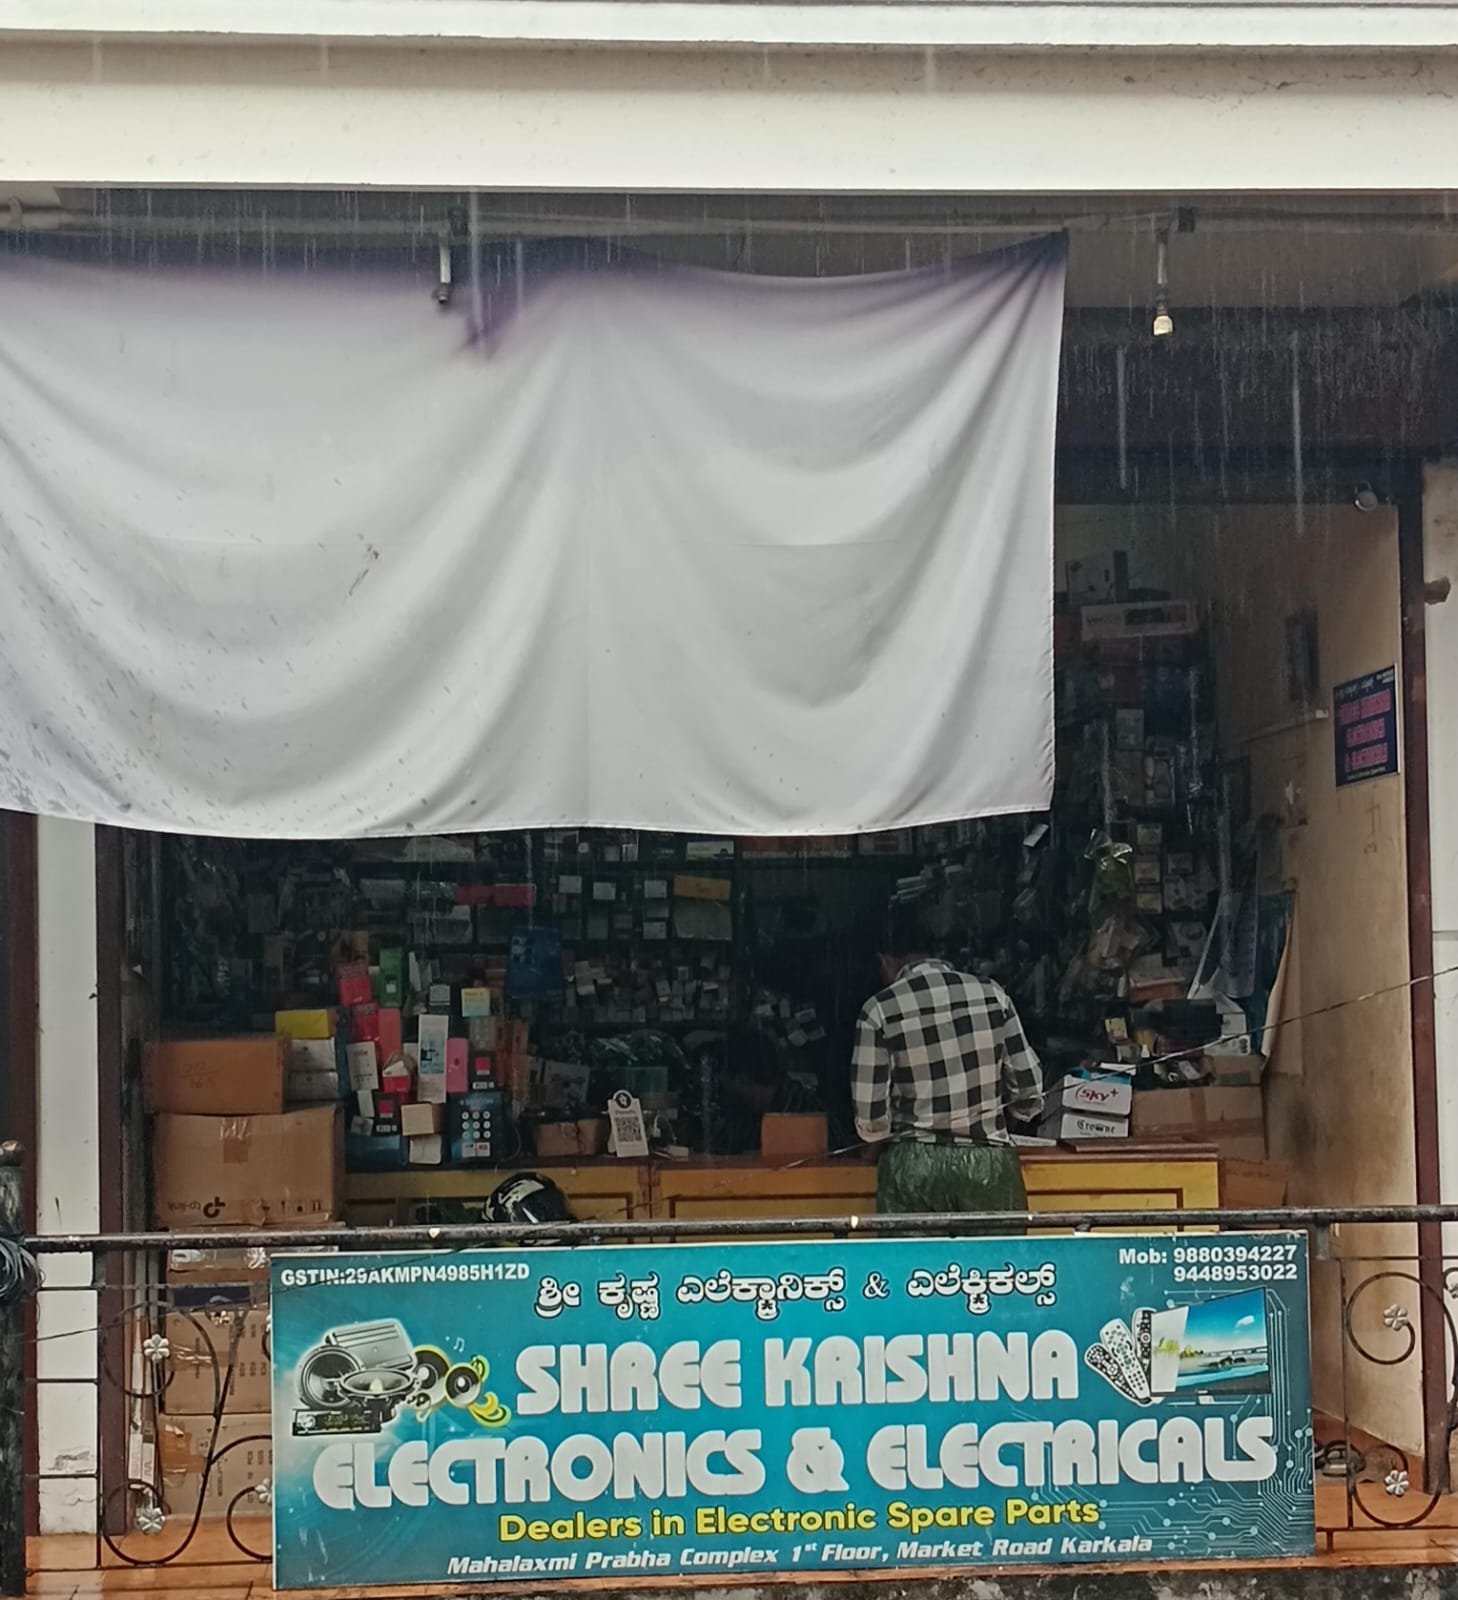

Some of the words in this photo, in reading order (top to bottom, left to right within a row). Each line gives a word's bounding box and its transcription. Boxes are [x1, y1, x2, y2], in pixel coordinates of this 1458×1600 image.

[281, 1263, 530, 1286] GSTIN:29AKMPN4985H1ZD
[1119, 1248, 1167, 1265] Mob:
[1173, 1245, 1298, 1264] 9880394227
[1173, 1264, 1298, 1282] 9448953022
[535, 1275, 581, 1318] ಶ್ರೀ
[598, 1271, 661, 1320] ಕೃಷ್ಣ
[862, 1271, 890, 1299] &
[516, 1339, 742, 1416] SHREE
[764, 1329, 1080, 1408] KRISHNA
[313, 1428, 766, 1511] ELECTRONICS
[787, 1426, 851, 1493] &
[866, 1415, 1279, 1491] ELECTRICALS
[499, 1510, 642, 1541] Dealers
[652, 1508, 685, 1536] in
[696, 1502, 877, 1534] Electronic
[887, 1501, 996, 1534] Spare
[1005, 1498, 1101, 1526] Parts
[447, 1552, 578, 1576] Mahalaxmi
[585, 1549, 672, 1570] Prabha
[679, 1547, 779, 1568] Complex
[791, 1542, 818, 1562] 1st
[821, 1542, 889, 1563] Floor,
[897, 1539, 983, 1559] Market
[992, 1537, 1052, 1556] Road
[1060, 1535, 1153, 1554] Karkala
